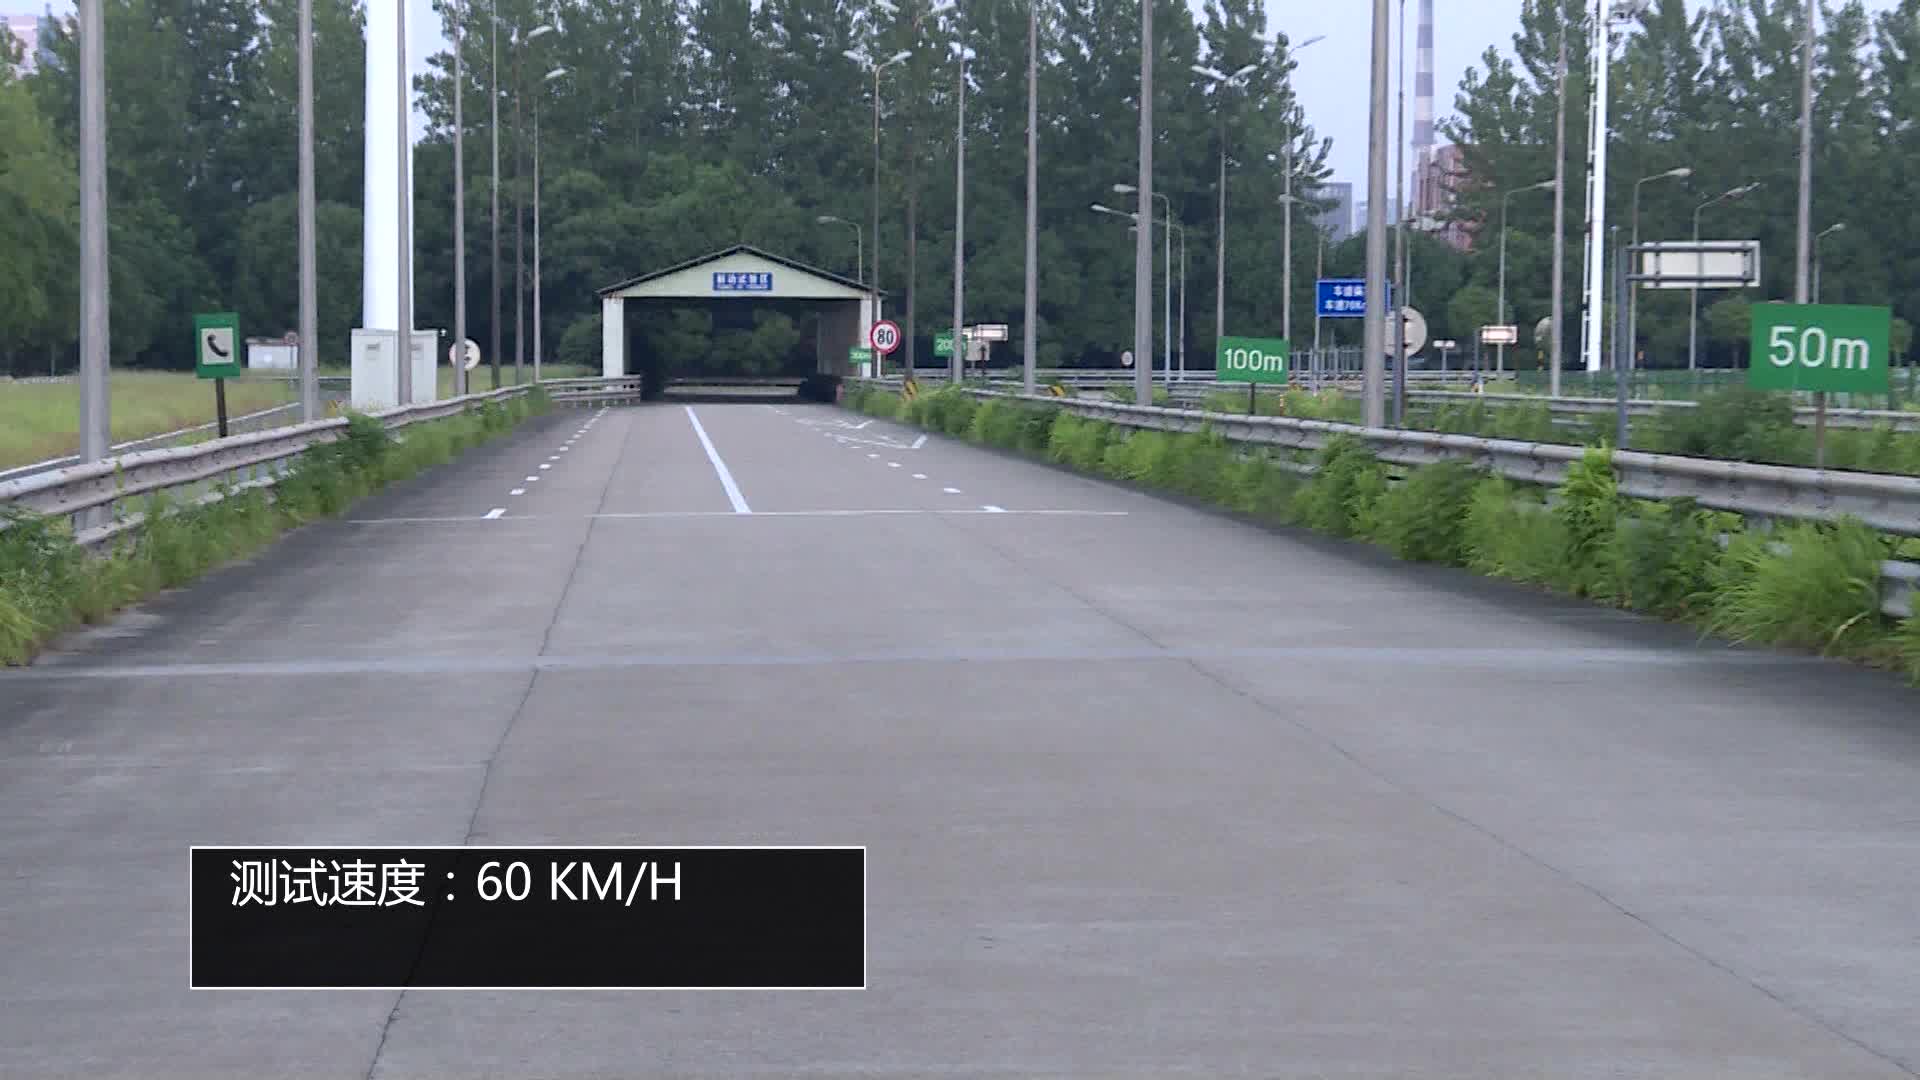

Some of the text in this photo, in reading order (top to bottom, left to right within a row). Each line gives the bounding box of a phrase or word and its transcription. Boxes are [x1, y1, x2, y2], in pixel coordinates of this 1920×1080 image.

[876, 328, 894, 345] 80
[1768, 325, 1870, 369] 50m
[1223, 348, 1283, 372] 100m
